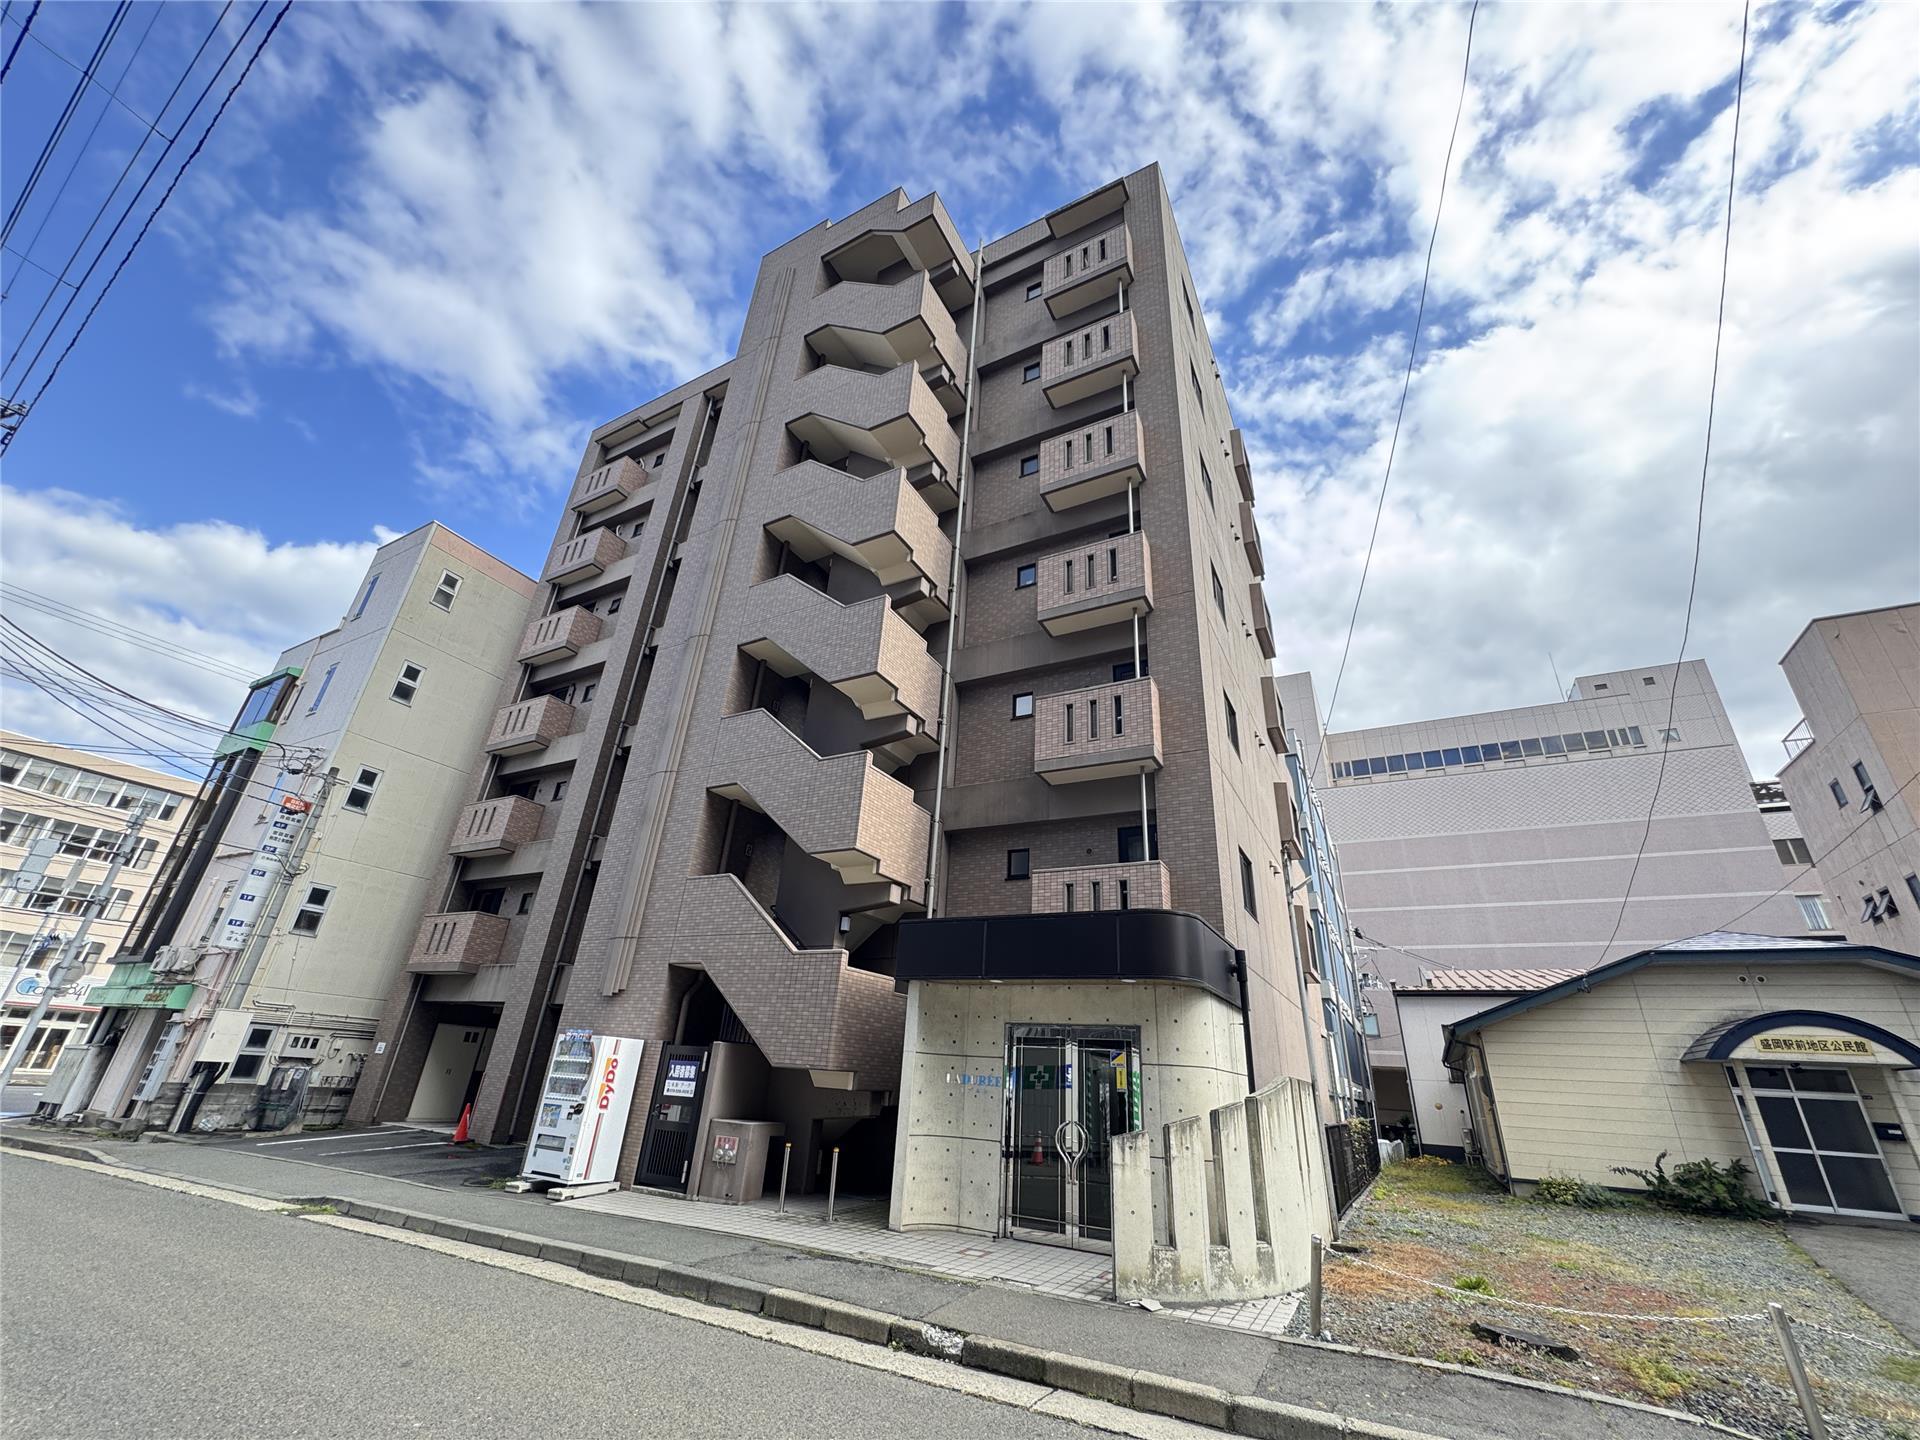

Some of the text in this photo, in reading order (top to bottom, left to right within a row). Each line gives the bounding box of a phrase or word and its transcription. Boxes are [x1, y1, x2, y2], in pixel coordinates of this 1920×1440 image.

[1760, 1038, 1868, 1053] 盛岡駅前地区公民館
[668, 1064, 696, 1079] 入居者募集
[599, 1058, 618, 1110] DyDo
